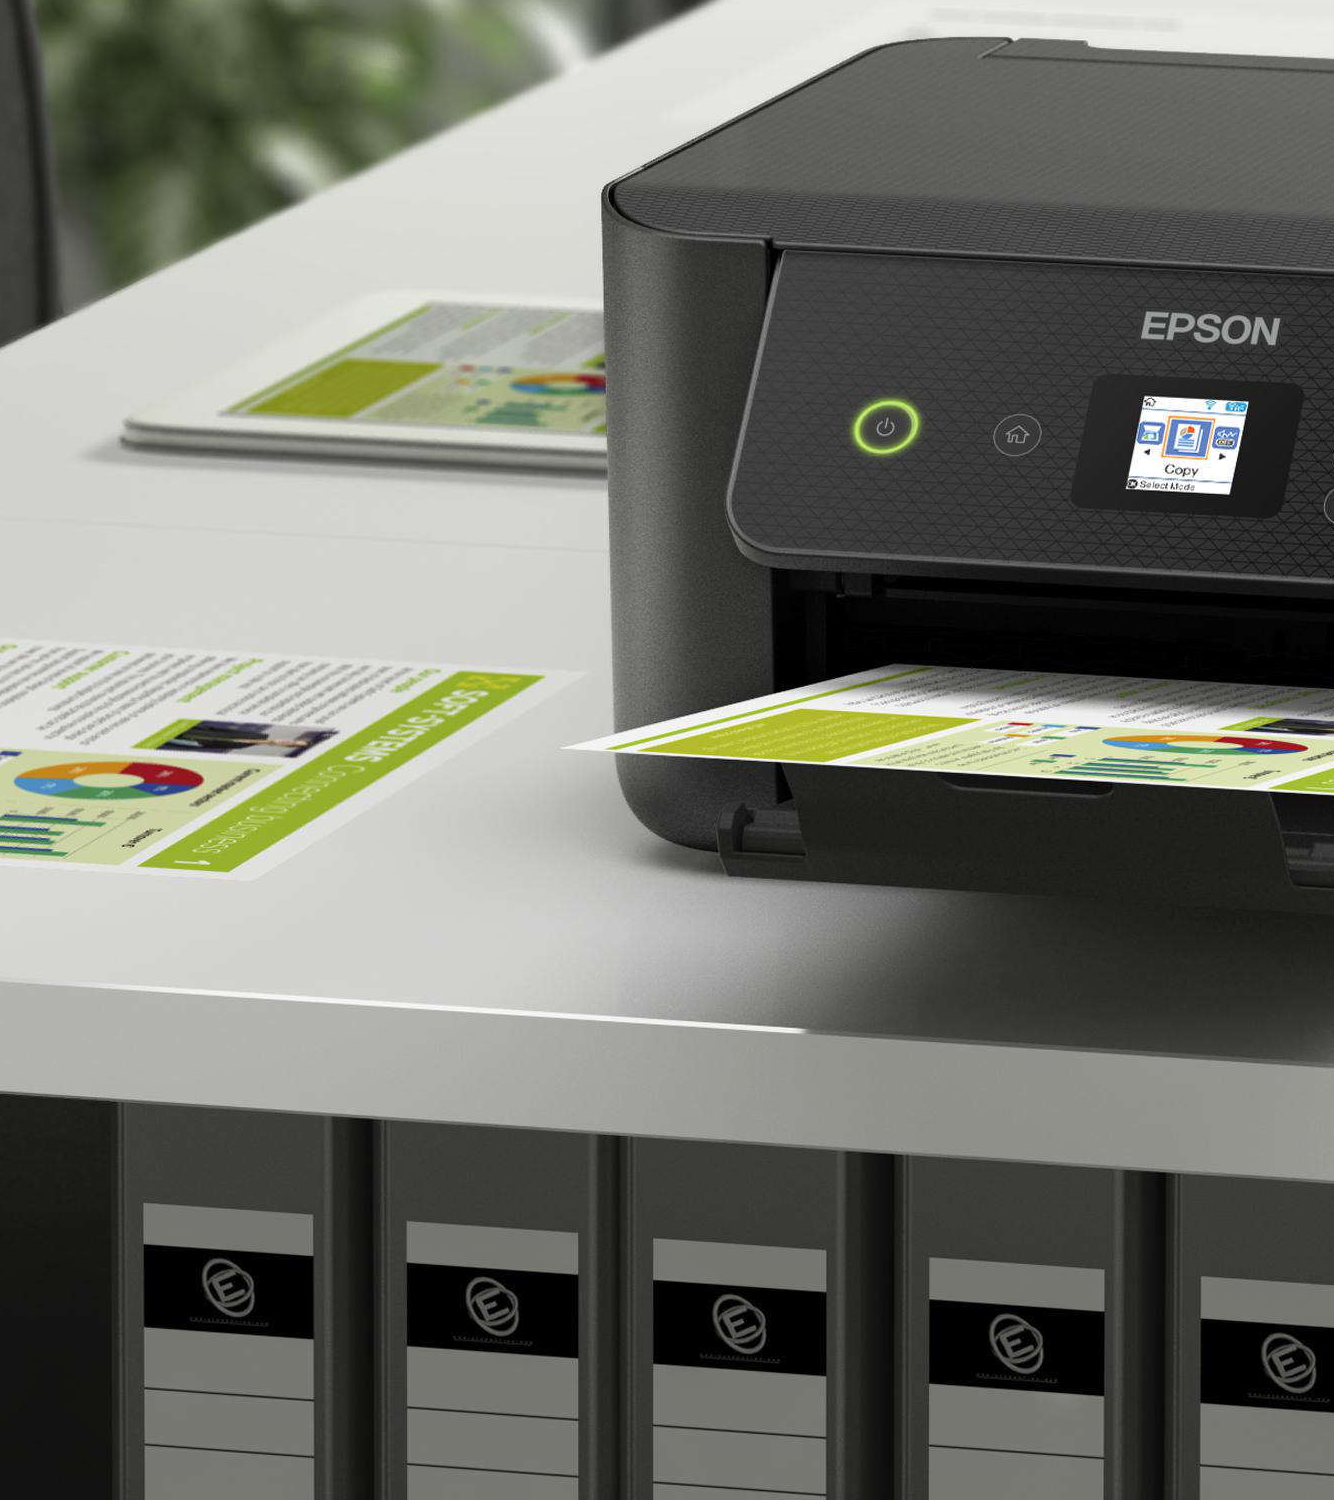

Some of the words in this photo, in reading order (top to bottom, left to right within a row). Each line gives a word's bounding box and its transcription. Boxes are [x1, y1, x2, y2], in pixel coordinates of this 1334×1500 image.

[1140, 310, 1281, 346] EPSON
[1139, 480, 1168, 491] Select
[1170, 482, 1195, 492] Mode
[1164, 463, 1199, 478] Copy
[344, 689, 489, 763] SOFT-SYSTEMS
[247, 764, 366, 815] Connecting
